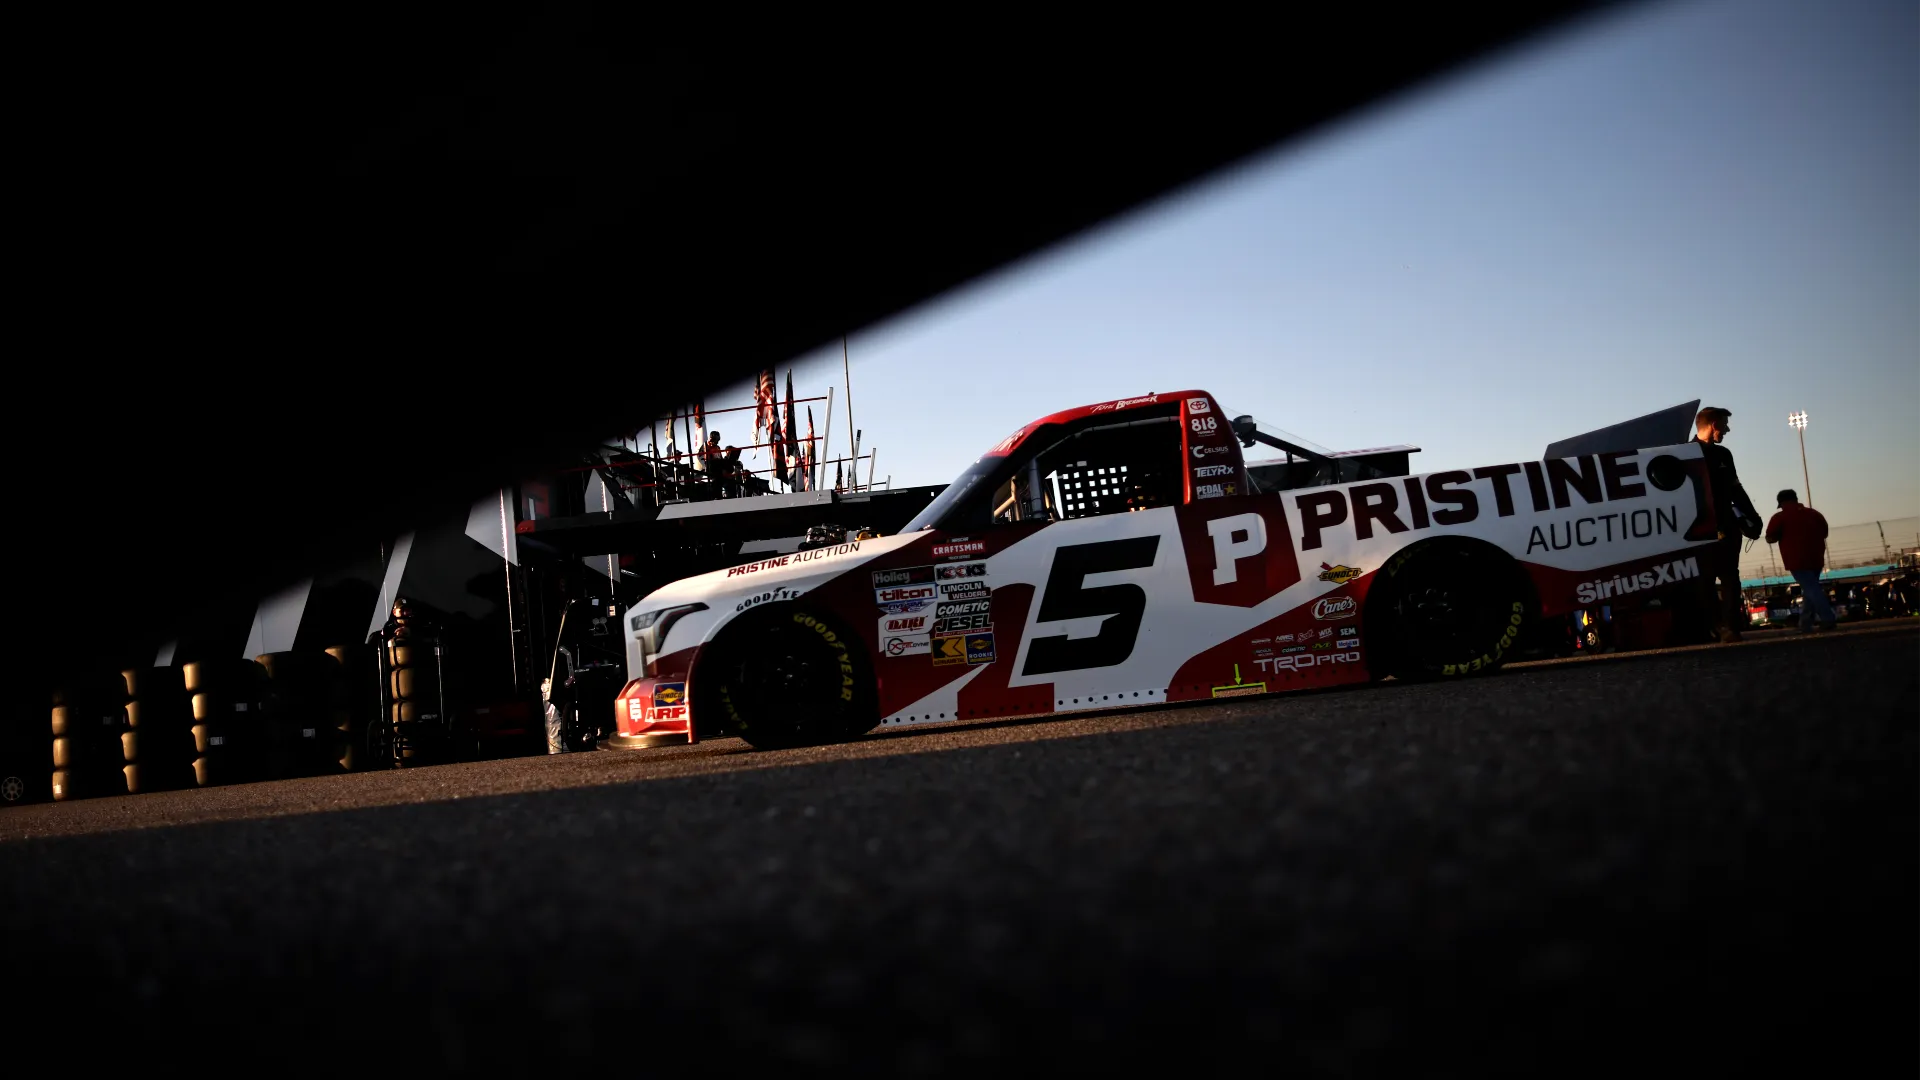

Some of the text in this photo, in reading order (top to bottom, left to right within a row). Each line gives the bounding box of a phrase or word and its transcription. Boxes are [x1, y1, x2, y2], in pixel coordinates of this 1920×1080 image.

[1191, 416, 1218, 431] 818
[1196, 484, 1223, 495] PEDAL
[1296, 449, 1646, 551] PRISTINE
[1527, 506, 1677, 554] AUCTION
[933, 543, 984, 555] CRAFTSMAN
[1207, 512, 1267, 586] P
[727, 542, 860, 577] PRISTINE AUCTION
[874, 571, 911, 584] Holley
[1321, 569, 1359, 580] SUNOCO
[1576, 556, 1699, 604] SiriusXM
[880, 588, 933, 601] tilton
[942, 583, 982, 593] LINCOLN
[952, 591, 987, 600] WELDERS
[937, 601, 990, 616] COMETIC
[1022, 535, 1161, 676] 5
[936, 614, 993, 632] JESEL
[1340, 627, 1356, 636] SEM
[655, 692, 685, 700] SUNOCO
[645, 706, 687, 721] ARP
